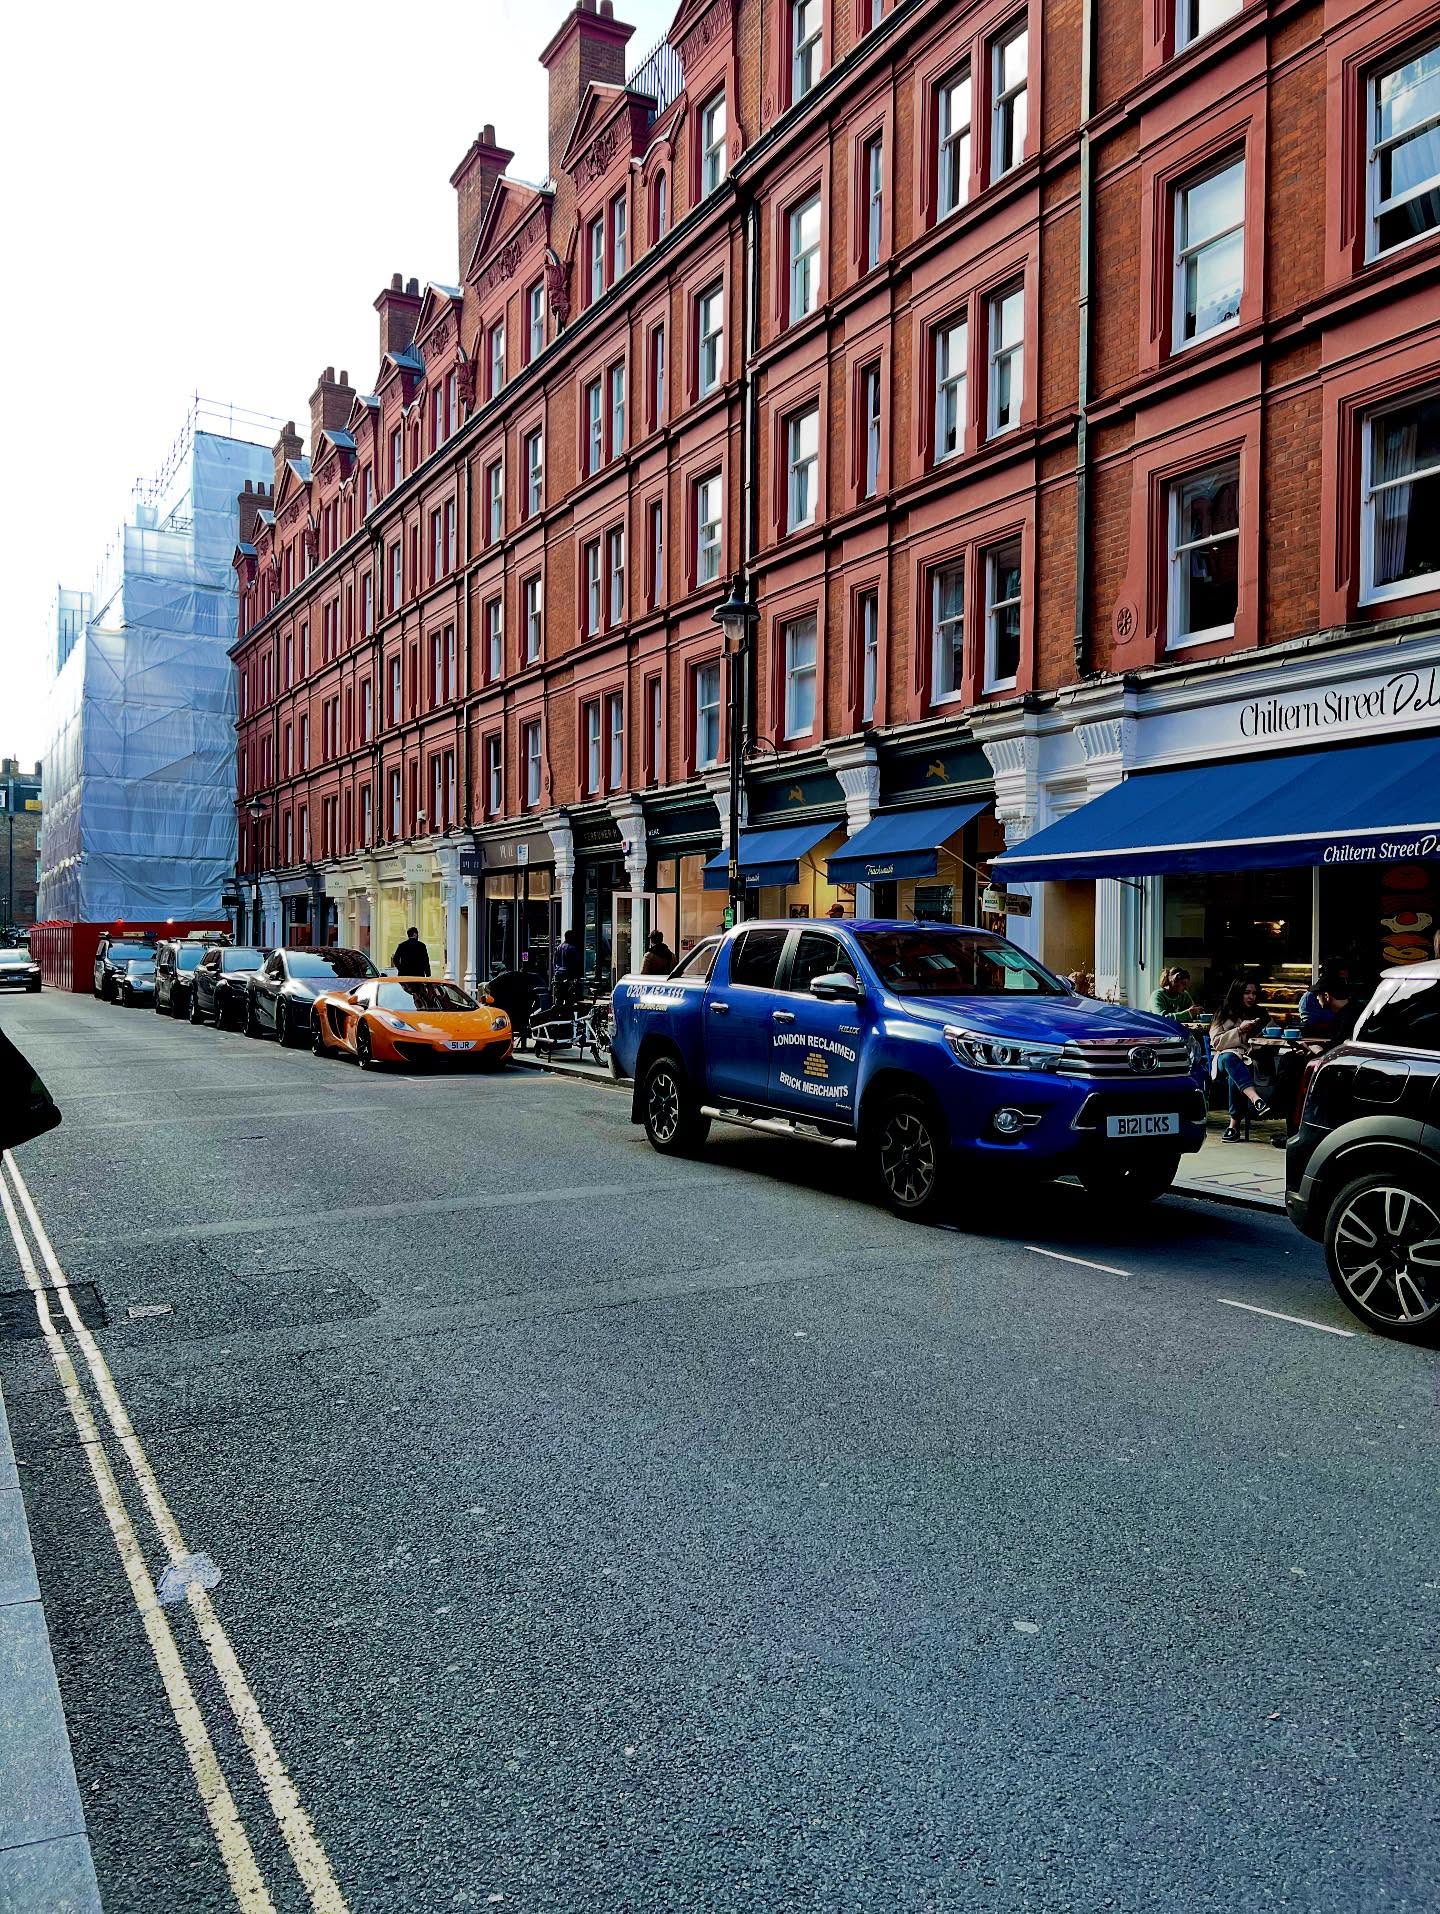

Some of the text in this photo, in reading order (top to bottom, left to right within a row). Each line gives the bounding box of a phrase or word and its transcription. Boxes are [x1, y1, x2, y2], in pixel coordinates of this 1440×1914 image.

[1240, 668, 1440, 736] Chiltern Street Del
[1323, 844, 1376, 862] Chiltern
[1379, 841, 1420, 859] Street
[773, 1033, 856, 1062] LONDON RECLAIMED
[779, 1071, 849, 1098] BRICK MERCHANTS
[1145, 1116, 1170, 1133] CKS
